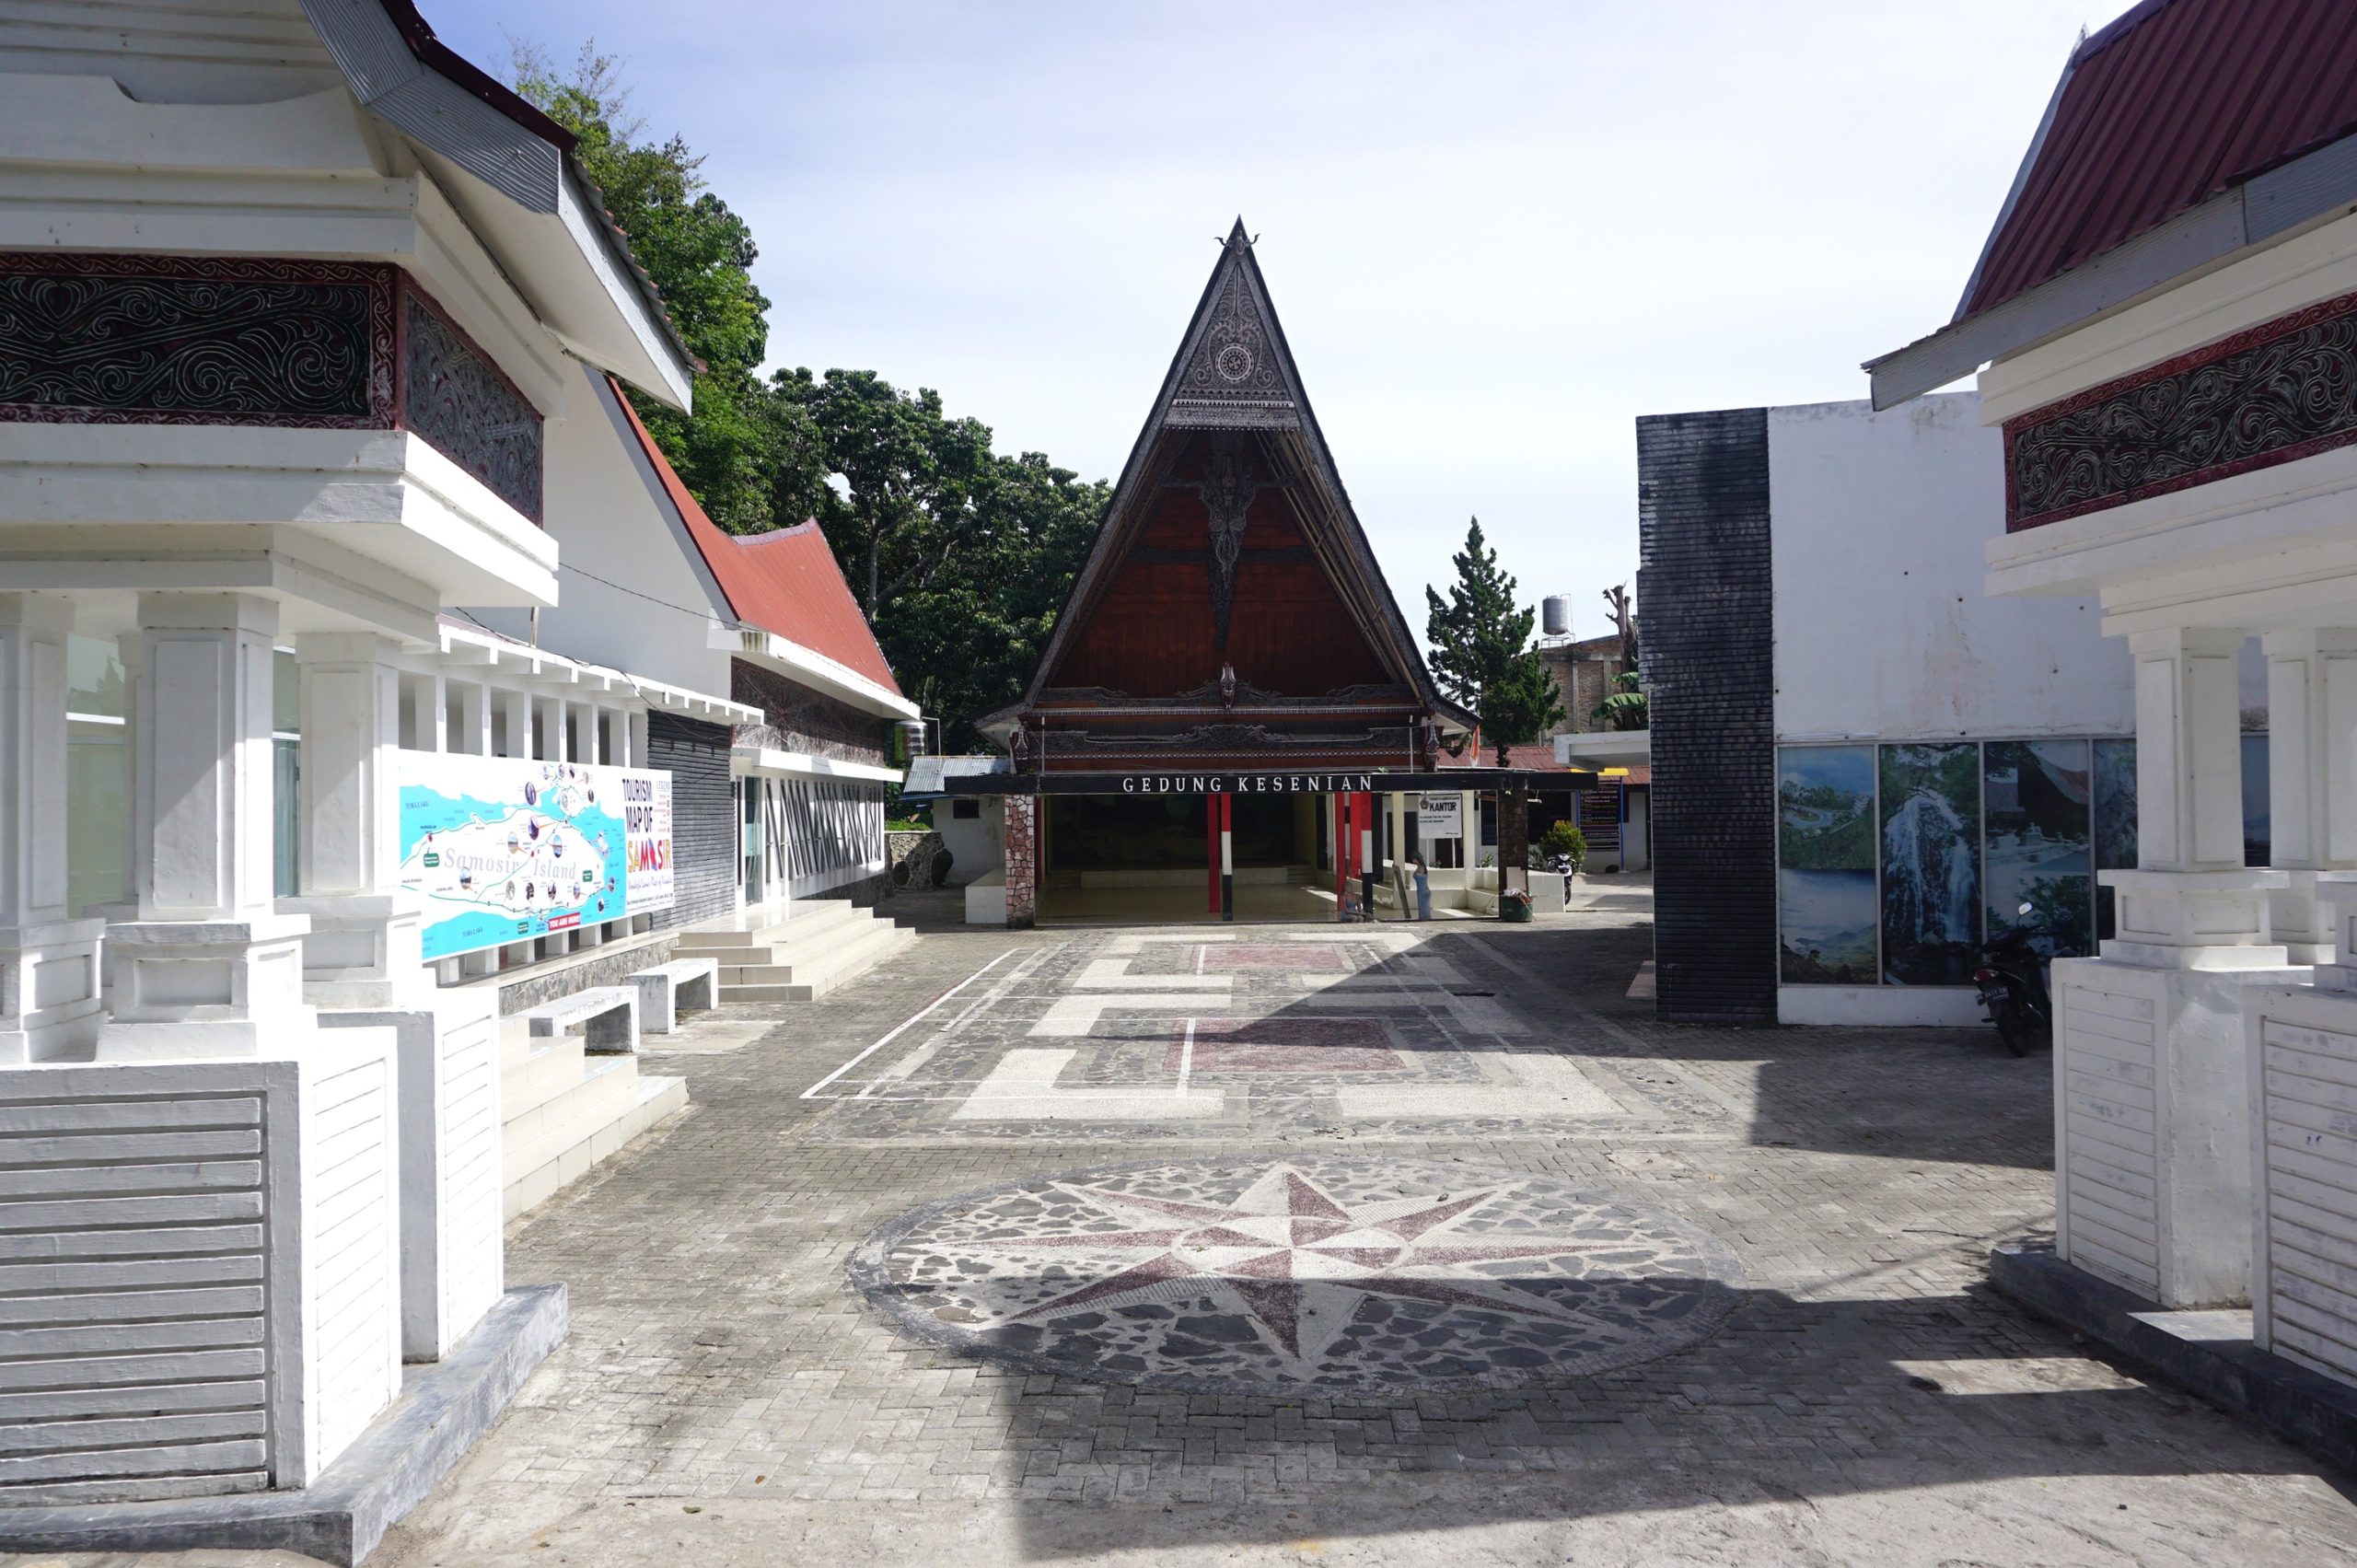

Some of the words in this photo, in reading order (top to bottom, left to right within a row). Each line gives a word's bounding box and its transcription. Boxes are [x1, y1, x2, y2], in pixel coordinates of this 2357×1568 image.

[621, 778, 653, 802] TOURISM
[1122, 777, 1222, 793] GEDUNG
[1237, 775, 1372, 792] KESENIAN
[1429, 801, 1457, 812] KANTOR
[626, 806, 643, 833] MAP
[644, 806, 653, 833] OF
[444, 847, 519, 876] Samosir
[533, 858, 576, 880] Island
[549, 918, 559, 929] YOU
